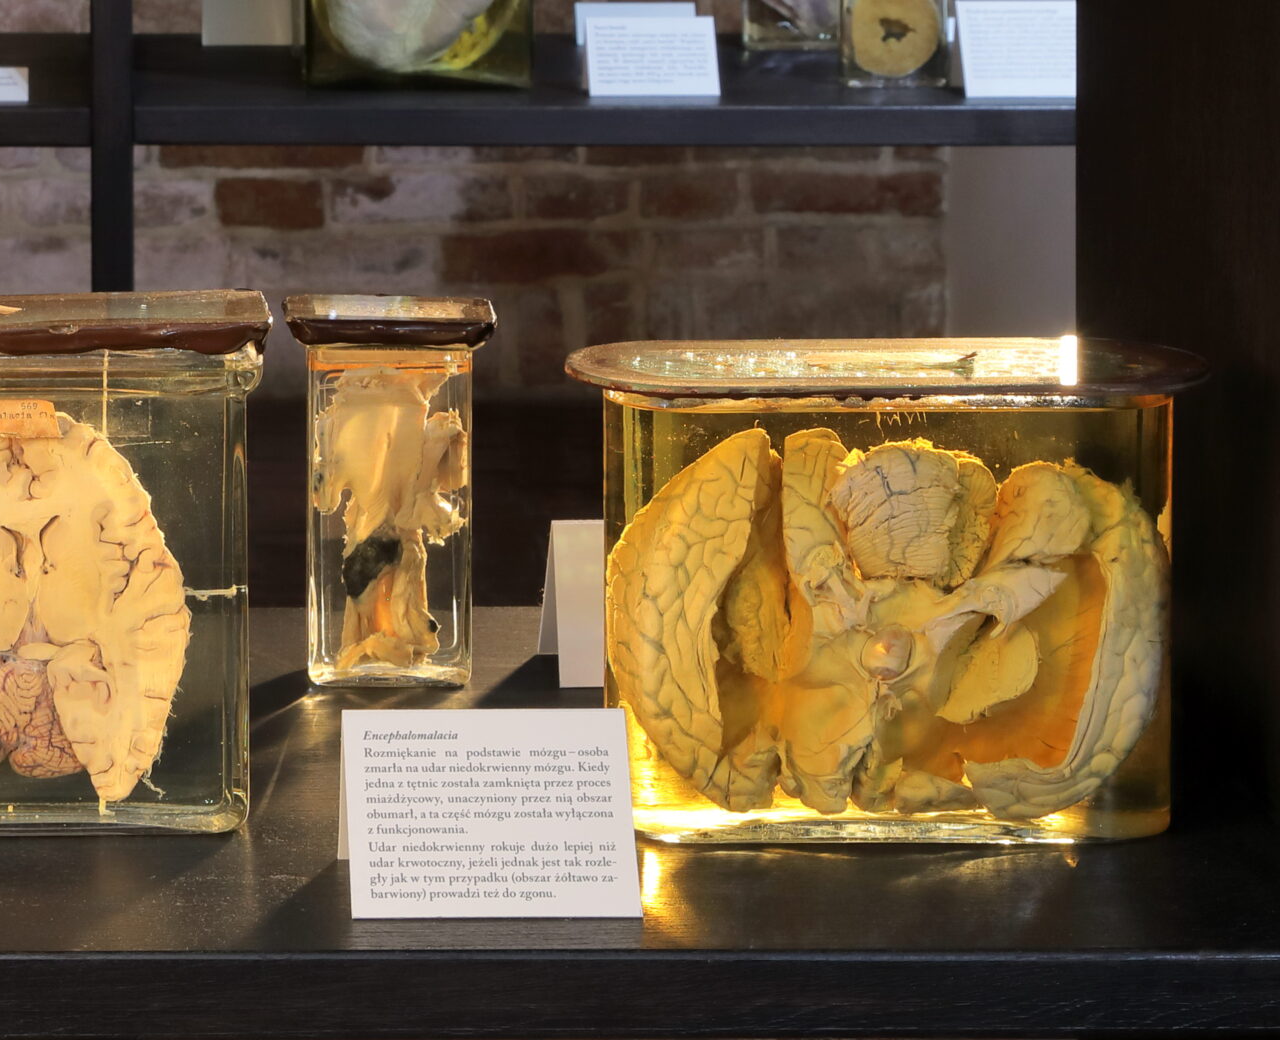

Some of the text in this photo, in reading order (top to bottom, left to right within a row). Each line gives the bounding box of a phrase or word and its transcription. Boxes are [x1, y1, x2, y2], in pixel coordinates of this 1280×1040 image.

[362, 730, 458, 744] Encephalomalacia
[364, 746, 521, 761] Rozmiękanie podstawie
[364, 761, 610, 776] zmarła udar niedokrwienny mózgu. Kiedy
[364, 777, 611, 792] jedna tętnic została zamknięta przez proces
[366, 792, 613, 807] miażdżycowy, unaczyniony przez nią obszar
[366, 807, 614, 822] obumarł, część mózgu została wyłączona
[376, 823, 468, 838] funkcjonowania.
[368, 840, 616, 855] Udar niedokrwienny rokuje dużo lepiej niż
[369, 856, 617, 871] udar krwotoczny, jeżeli jednak jest tak rozle-
[369, 871, 618, 887] gły jak tym przypadku (obszar żółtawo za-
[370, 887, 557, 902] barwiony) prowadzi też zgonu.
